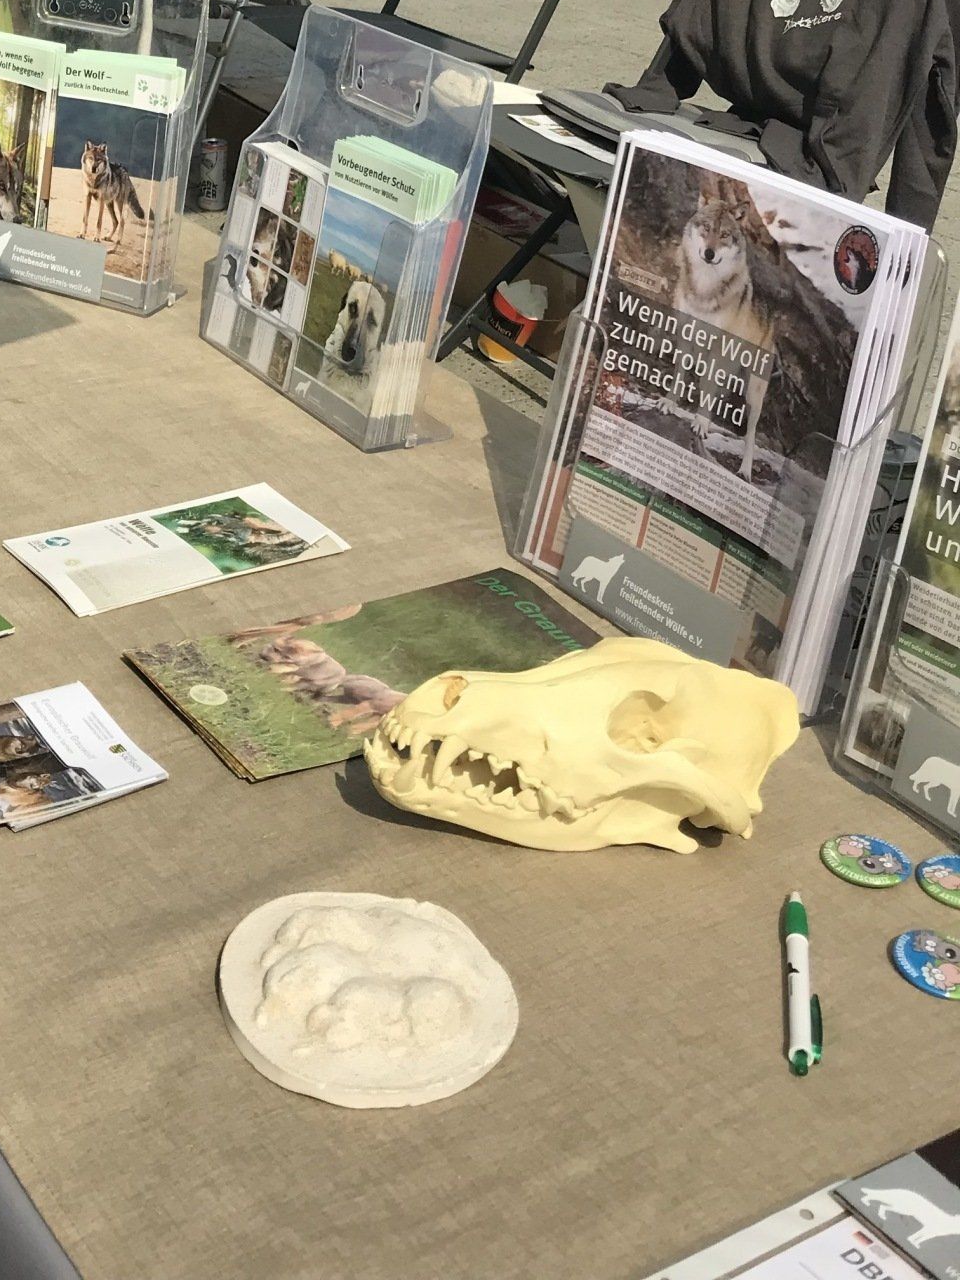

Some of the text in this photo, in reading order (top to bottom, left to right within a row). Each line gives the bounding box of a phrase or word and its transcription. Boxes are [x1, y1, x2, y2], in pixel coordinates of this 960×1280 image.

[5, 52, 23, 62] wenn
[24, 55, 34, 64] Sie
[12, 63, 44, 79] begegnen?
[66, 66, 81, 77] Der
[84, 69, 105, 80] Wolf
[64, 81, 84, 90] zurück
[337, 153, 416, 196] Vorbeugender Schutz
[11, 253, 49, 270] freilebender
[50, 262, 68, 274] Wölfe
[13, 244, 57, 262] Freundeskreis
[618, 291, 770, 375] Wenn der Wolf
[609, 321, 746, 397] zum Problem
[603, 348, 747, 428] gemacht wird
[475, 577, 518, 597] Der
[622, 576, 674, 615] Freundeskreis
[619, 587, 703, 649] freilebender Wölfe e.V.
